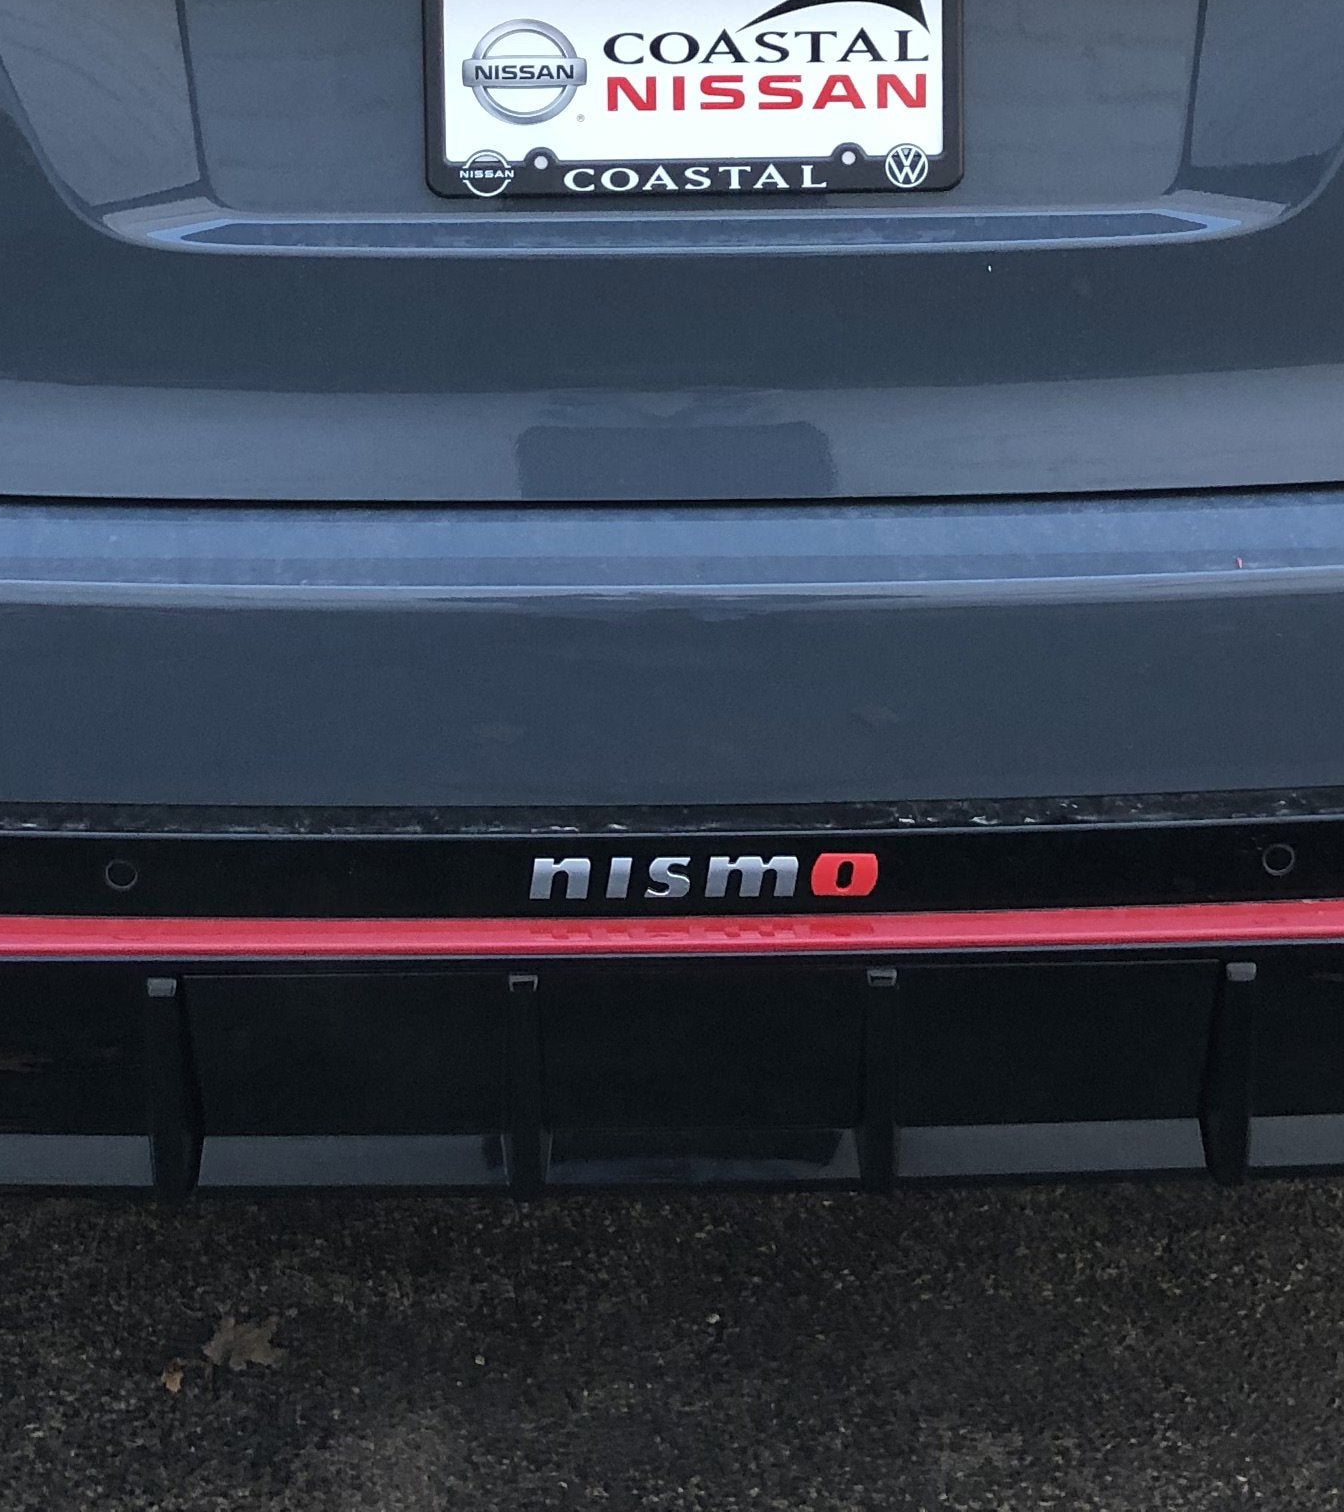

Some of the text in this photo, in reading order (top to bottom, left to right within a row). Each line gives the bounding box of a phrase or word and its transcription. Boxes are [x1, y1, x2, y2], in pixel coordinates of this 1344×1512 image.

[603, 27, 930, 66] COASTAL
[474, 61, 575, 81] NISSAN
[606, 73, 927, 112] NISSAN
[459, 169, 515, 178] NISSAN
[563, 164, 828, 192] COASTAL
